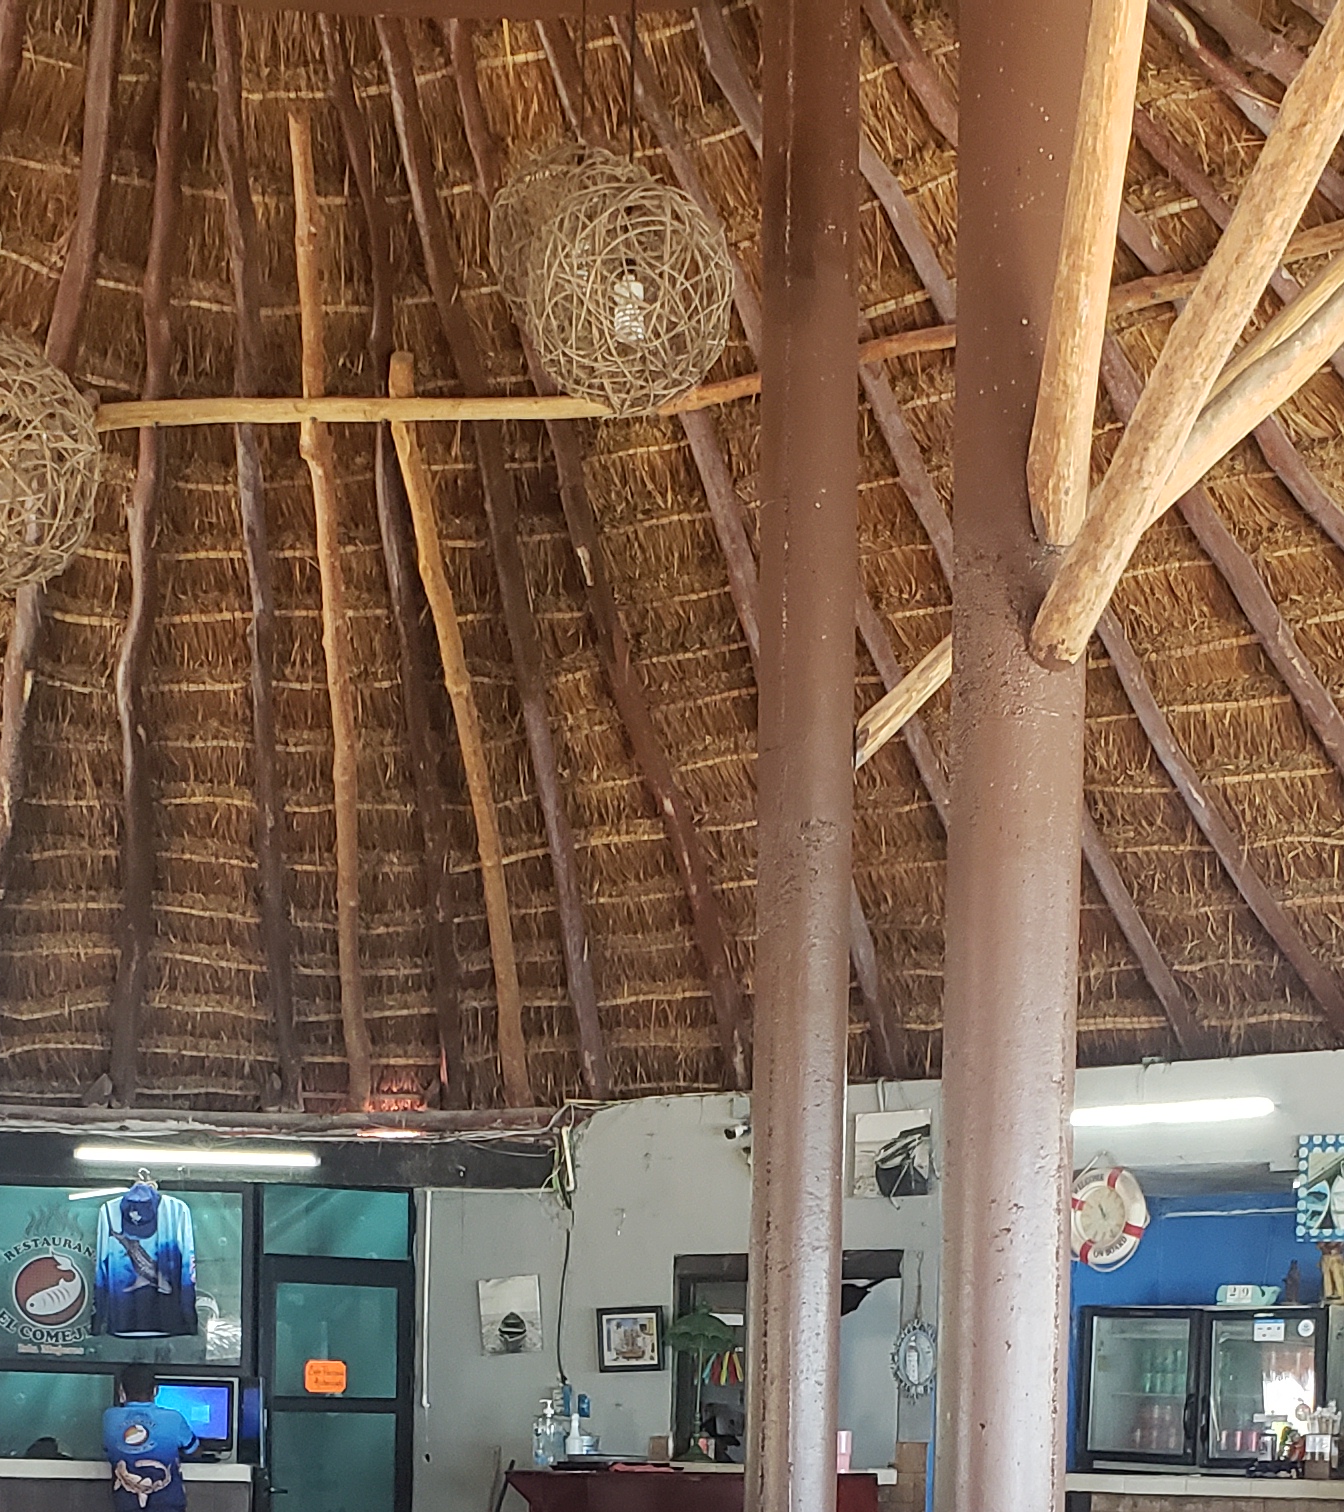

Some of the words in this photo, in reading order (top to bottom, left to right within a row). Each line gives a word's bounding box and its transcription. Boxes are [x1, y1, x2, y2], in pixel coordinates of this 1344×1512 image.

[3, 1236, 97, 1263] RESTAURAN
[1093, 1247, 1104, 1258] ON
[1105, 1236, 1128, 1256] BOARD
